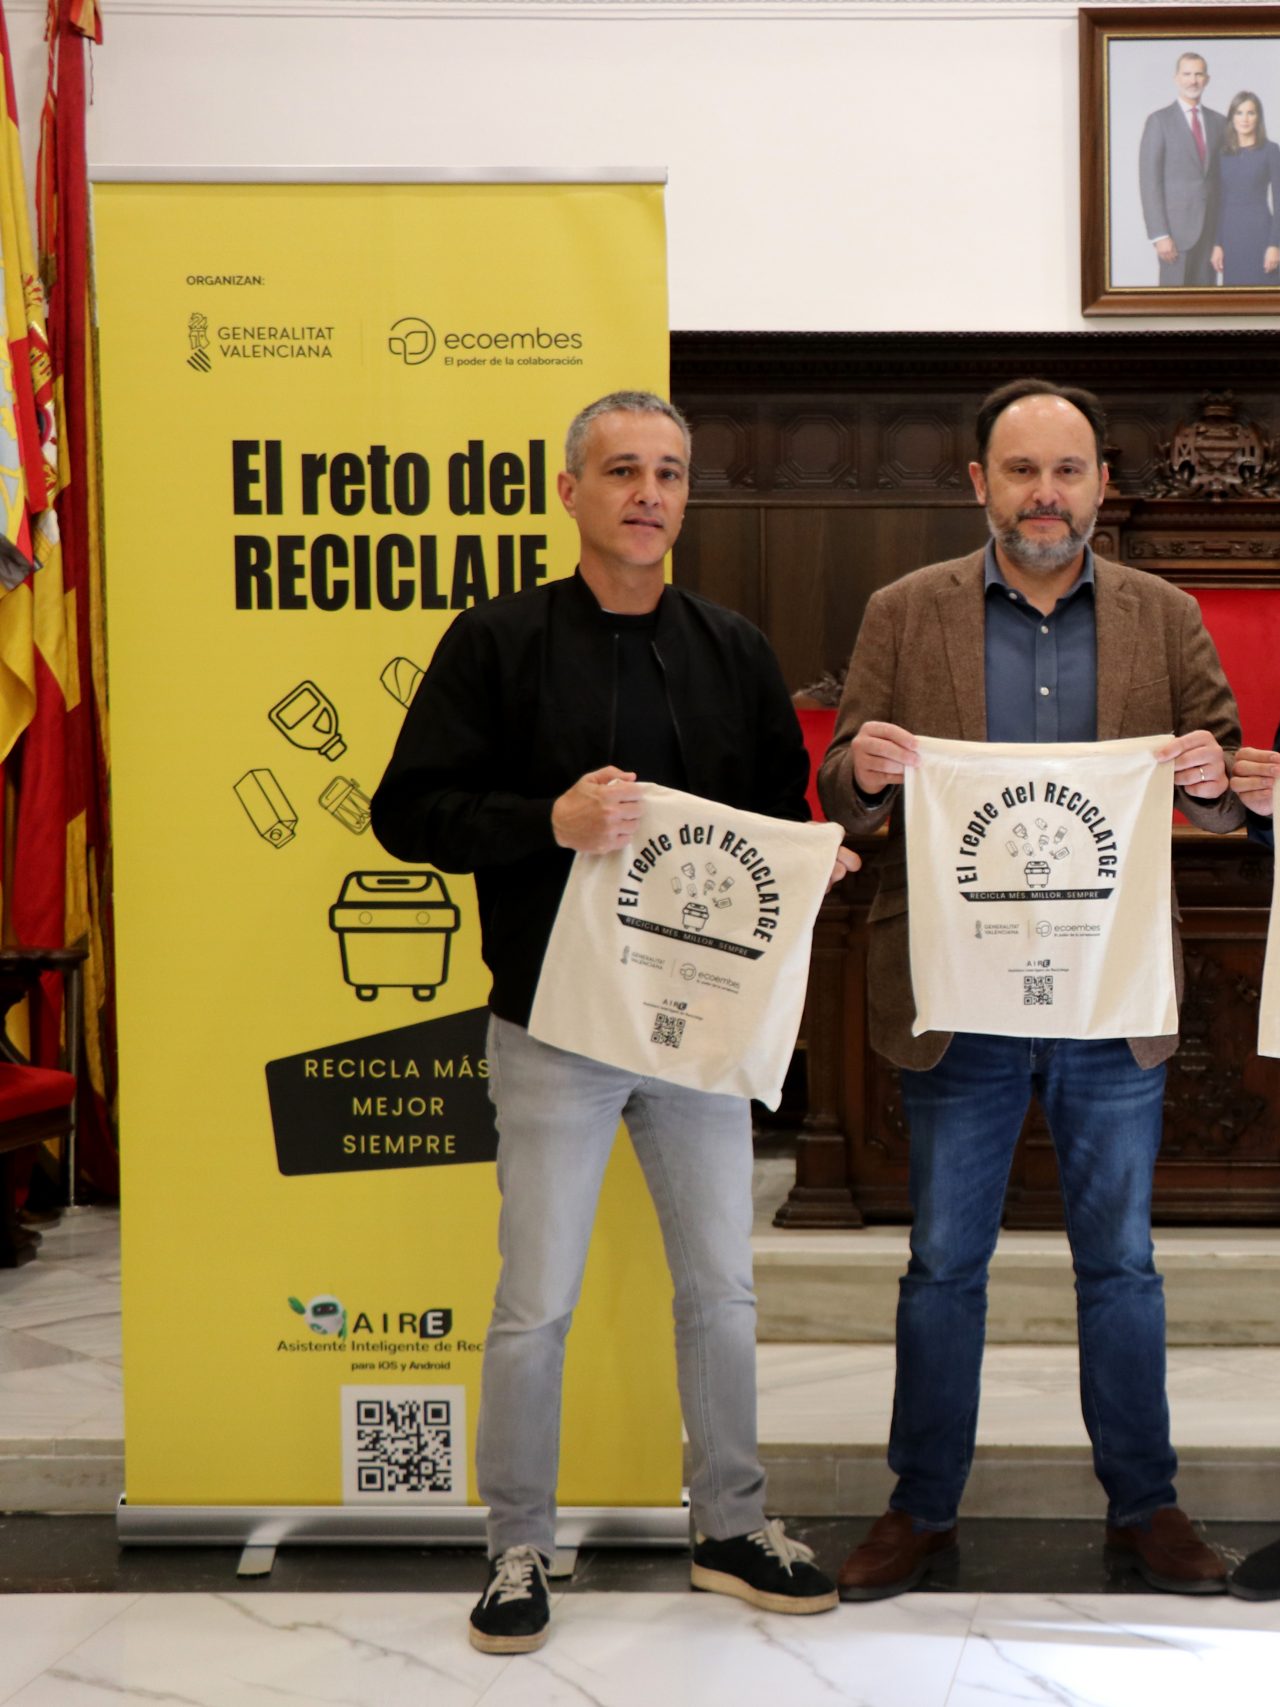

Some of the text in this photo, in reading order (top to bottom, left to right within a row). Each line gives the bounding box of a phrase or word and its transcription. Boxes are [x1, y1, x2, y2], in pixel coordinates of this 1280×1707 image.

[186, 276, 264, 285] ORGANIZAN:
[218, 327, 334, 340] GENERALITAT
[444, 327, 582, 349] ecoembes
[220, 345, 332, 358] VALENCIANA
[445, 356, 582, 366] El poder de la colaboración
[232, 440, 546, 515] El reto del
[956, 782, 1117, 884] El repte del RECICLATGE
[618, 824, 780, 943] El repte del RECICLATGE
[625, 917, 660, 932] RECICLA
[719, 942, 748, 956] SEMPRE
[1054, 923, 1100, 932] ecoembes
[698, 971, 740, 989] ecoembes
[305, 1055, 490, 1078] RECICLA MÁS
[353, 1097, 444, 1116] MEJOR
[343, 1135, 456, 1154] SIEMPRE
[353, 1311, 447, 1335] AIRE
[277, 1340, 346, 1350] Asistente
[351, 1340, 429, 1354] Inteligente
[434, 1340, 451, 1350] de
[351, 1362, 375, 1371] para
[400, 1362, 406, 1371] y
[409, 1361, 450, 1370] Android
